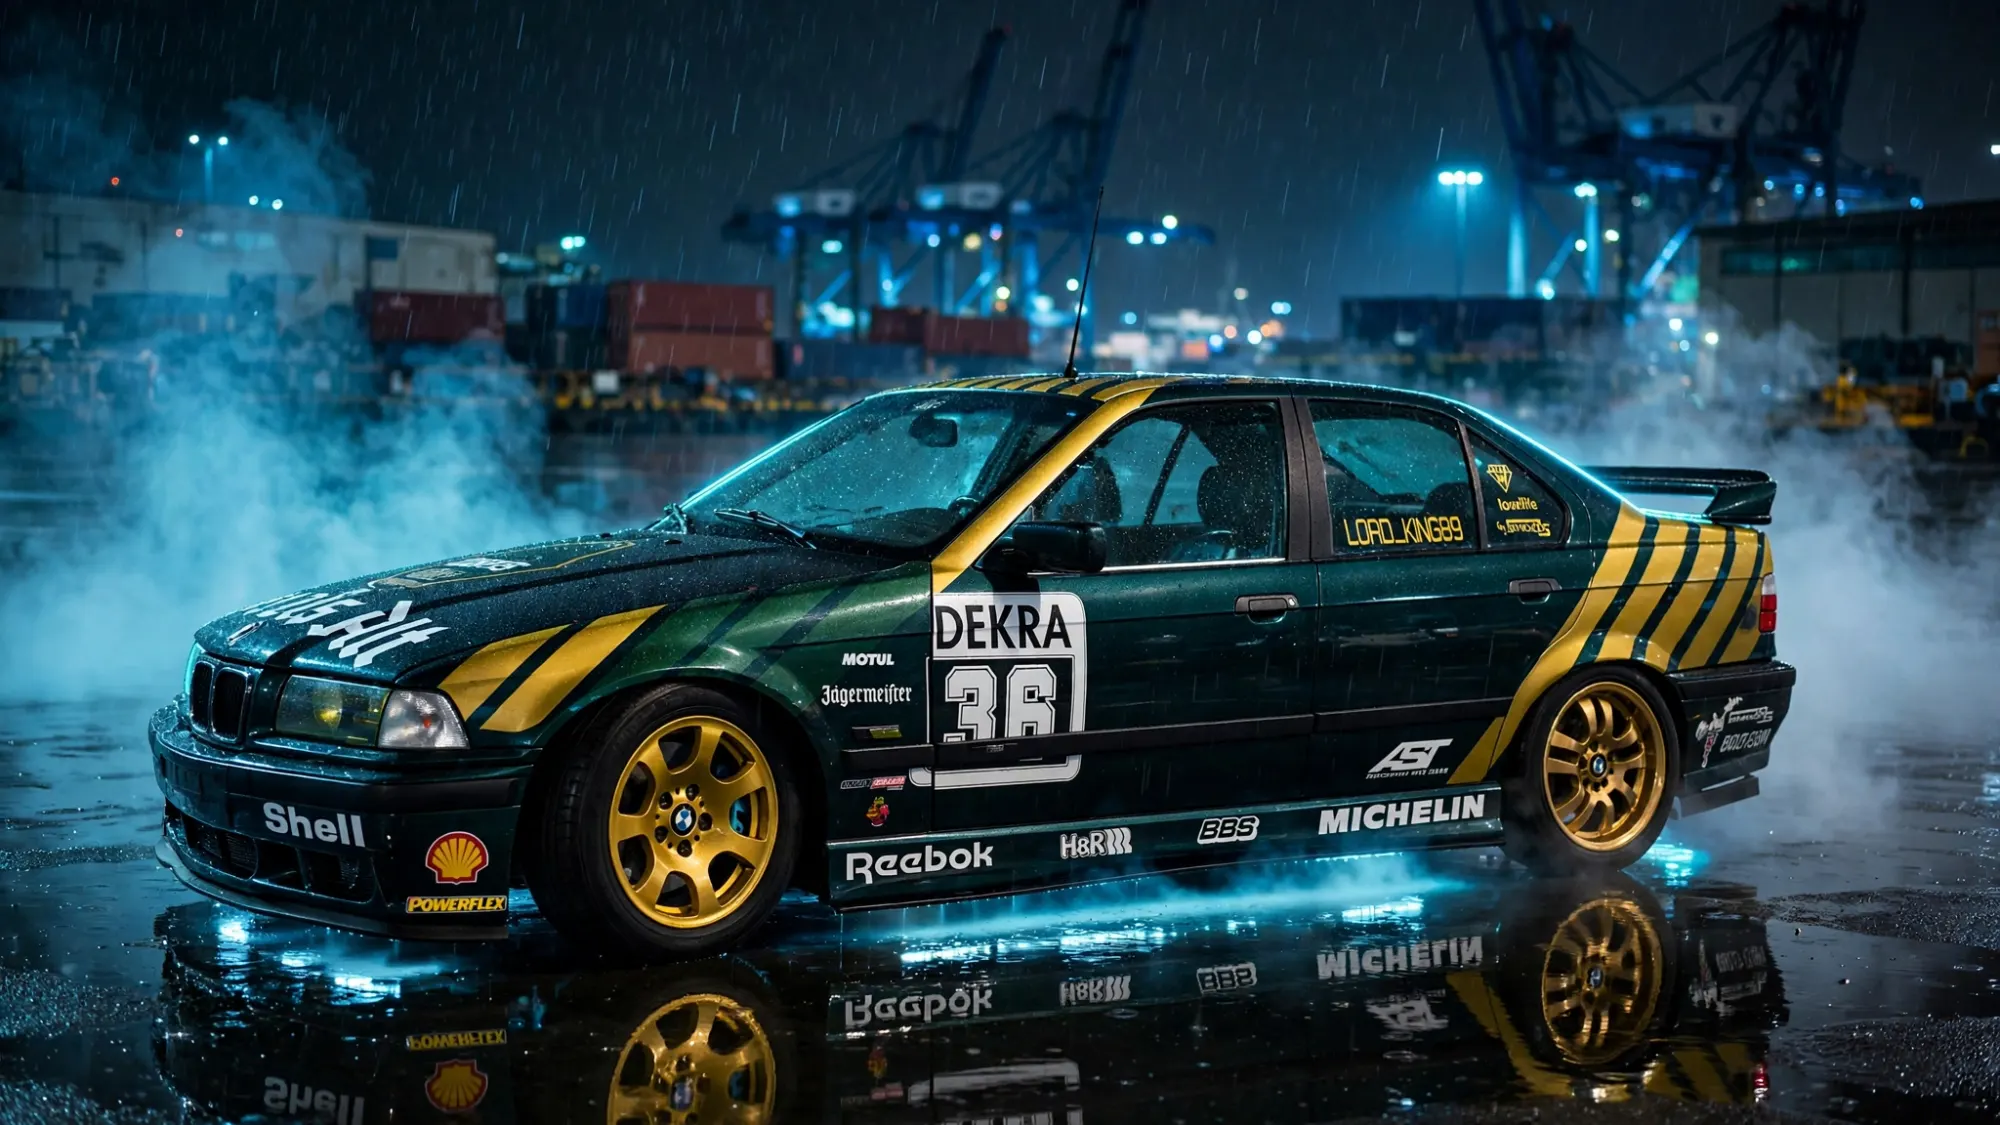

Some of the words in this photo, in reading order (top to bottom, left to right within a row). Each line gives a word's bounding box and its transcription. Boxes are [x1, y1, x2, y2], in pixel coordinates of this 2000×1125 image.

[934, 604, 1072, 650] DEKRA
[841, 652, 895, 666] MOTUL
[943, 664, 1057, 745] 36
[1368, 738, 1453, 773] AST
[263, 802, 365, 847] Shell
[1197, 815, 1260, 844] BBS
[1318, 794, 1485, 835] MICHELIN
[846, 842, 994, 884] Reebok
[407, 896, 505, 912] POWERFLEX
